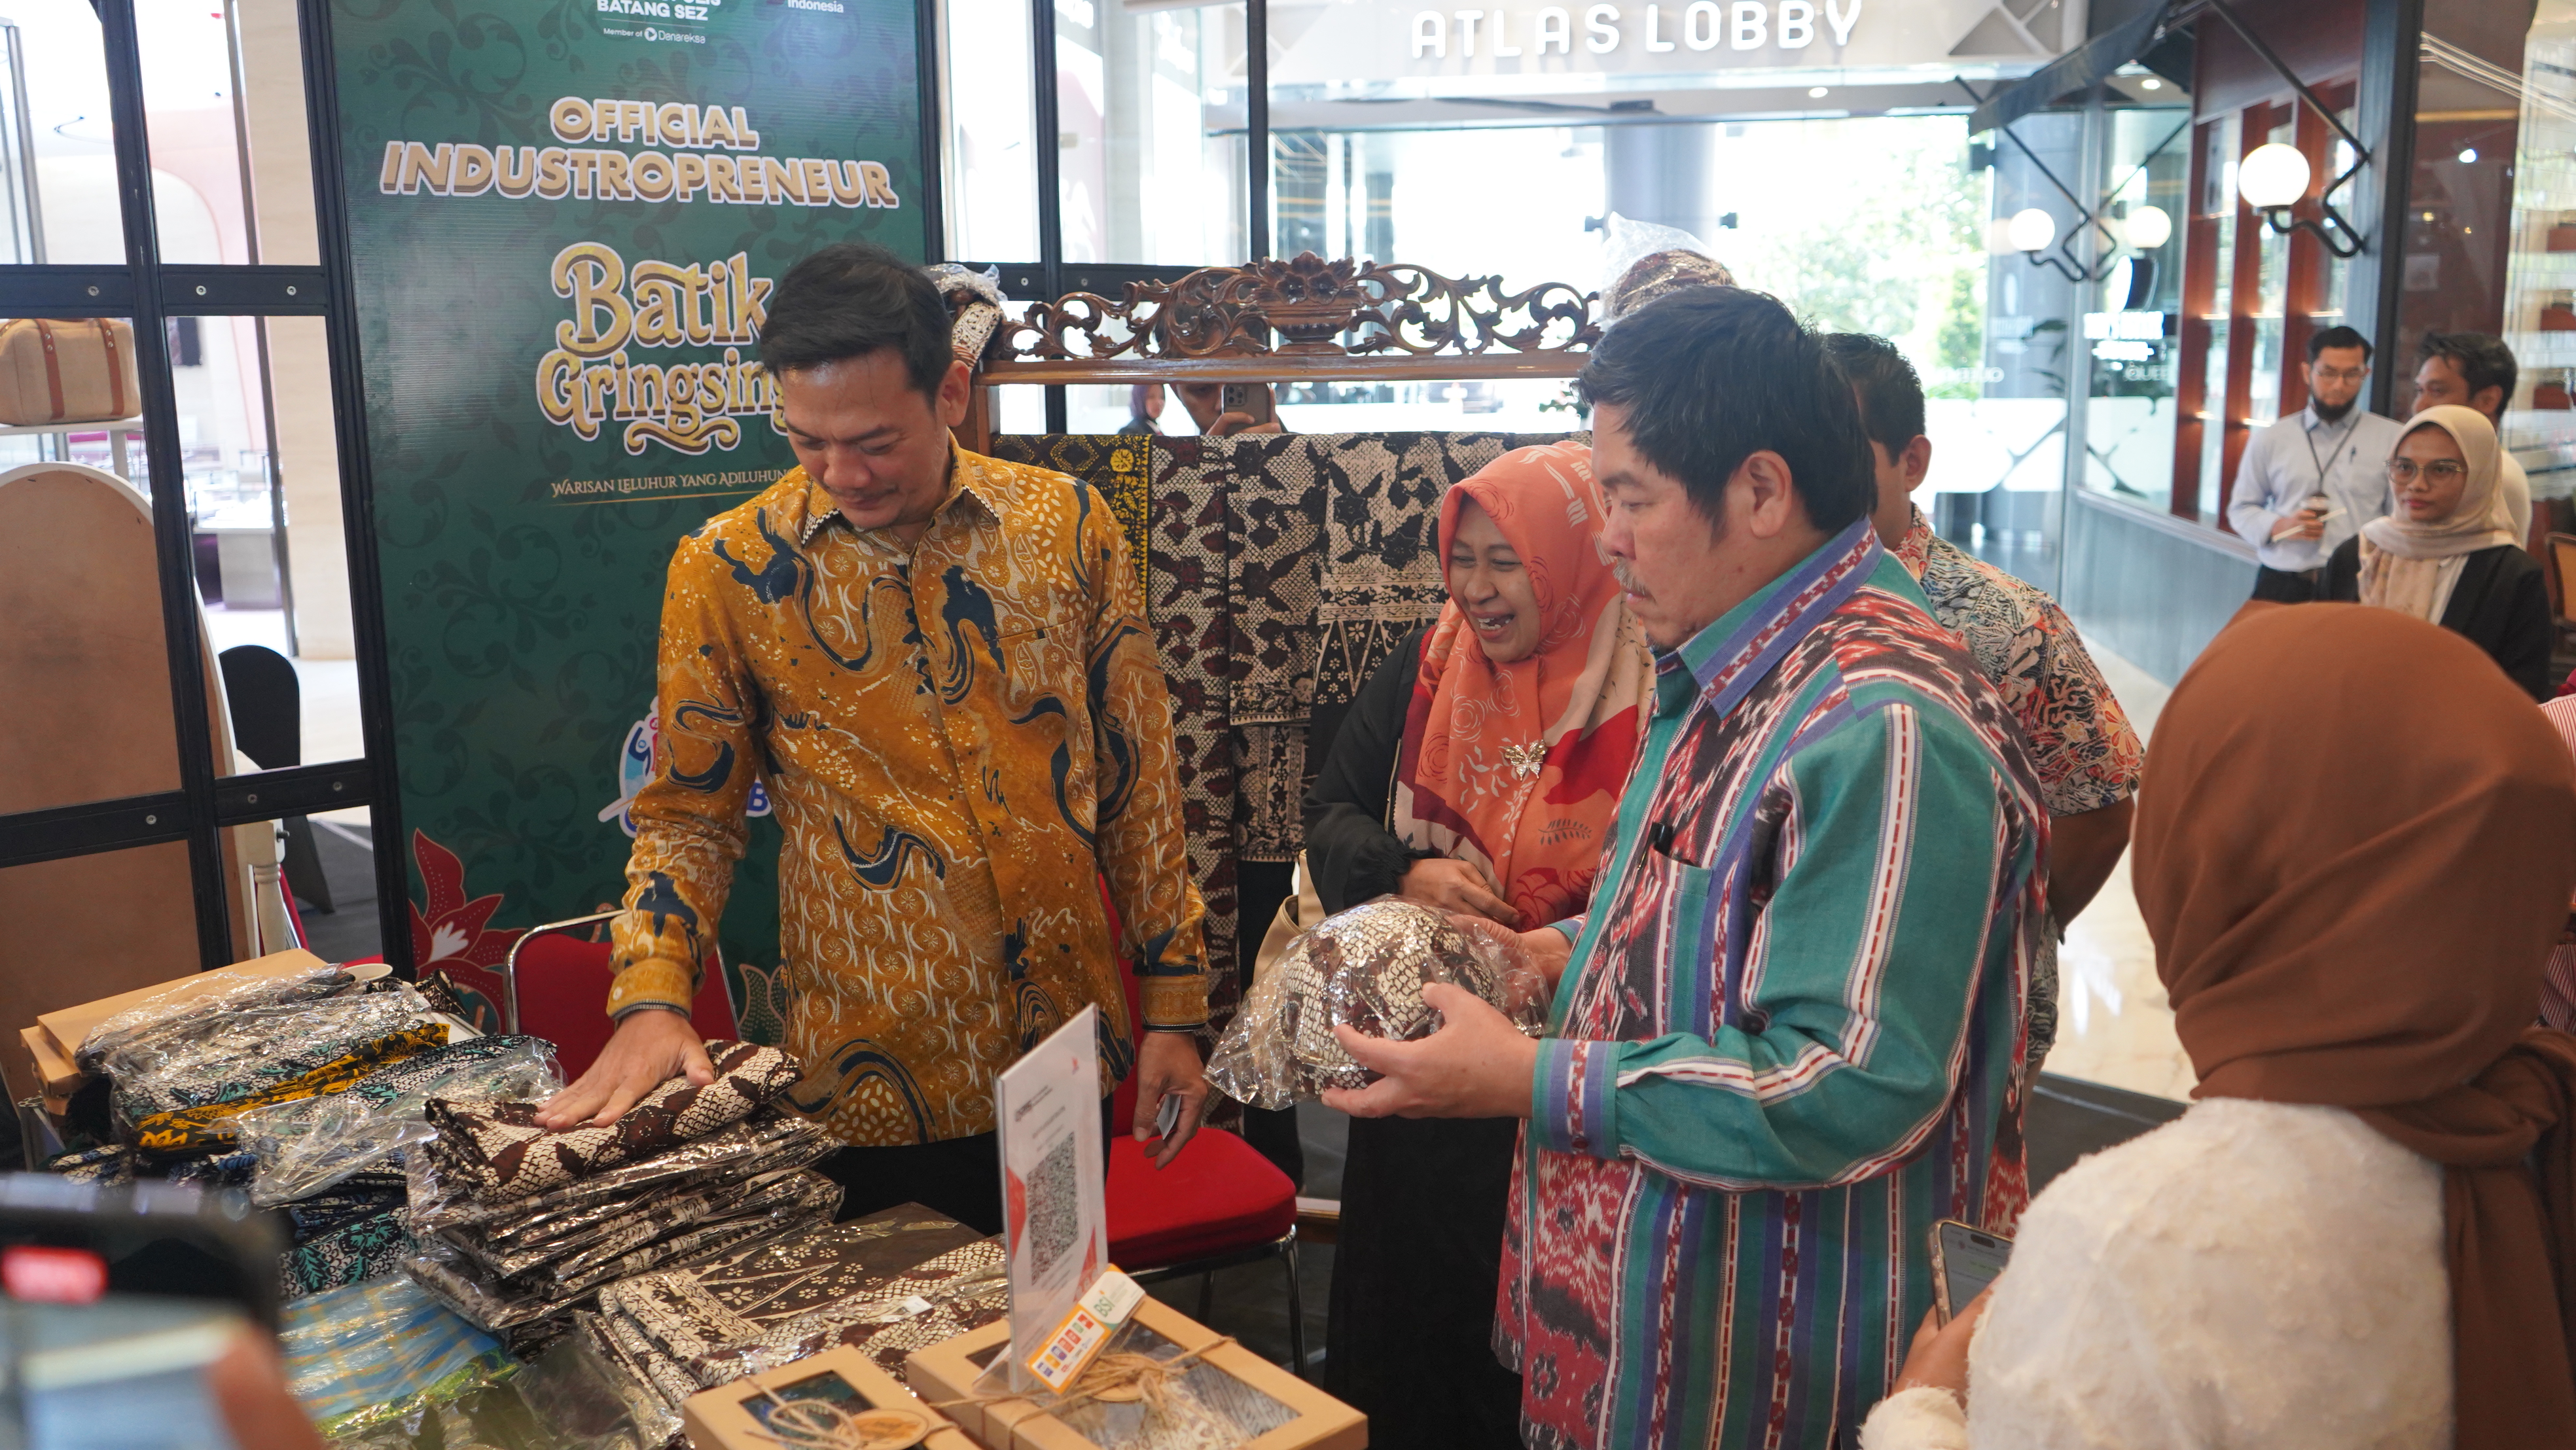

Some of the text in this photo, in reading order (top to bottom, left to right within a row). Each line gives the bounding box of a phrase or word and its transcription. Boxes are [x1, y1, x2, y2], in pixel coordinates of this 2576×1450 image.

[597, 0, 708, 21] BATANG SEZ
[787, 0, 844, 13] Indonesia
[603, 27, 635, 37] Member
[658, 30, 706, 44] Danareksa
[1411, 0, 1862, 59] ATLAS LOBBY
[550, 96, 759, 150] OFFICIAL
[380, 141, 900, 209] INDUSTROPRENEUR
[551, 241, 773, 359] Batik
[551, 469, 792, 497] WARISAN LELUHUR YANG ADILUHUN
